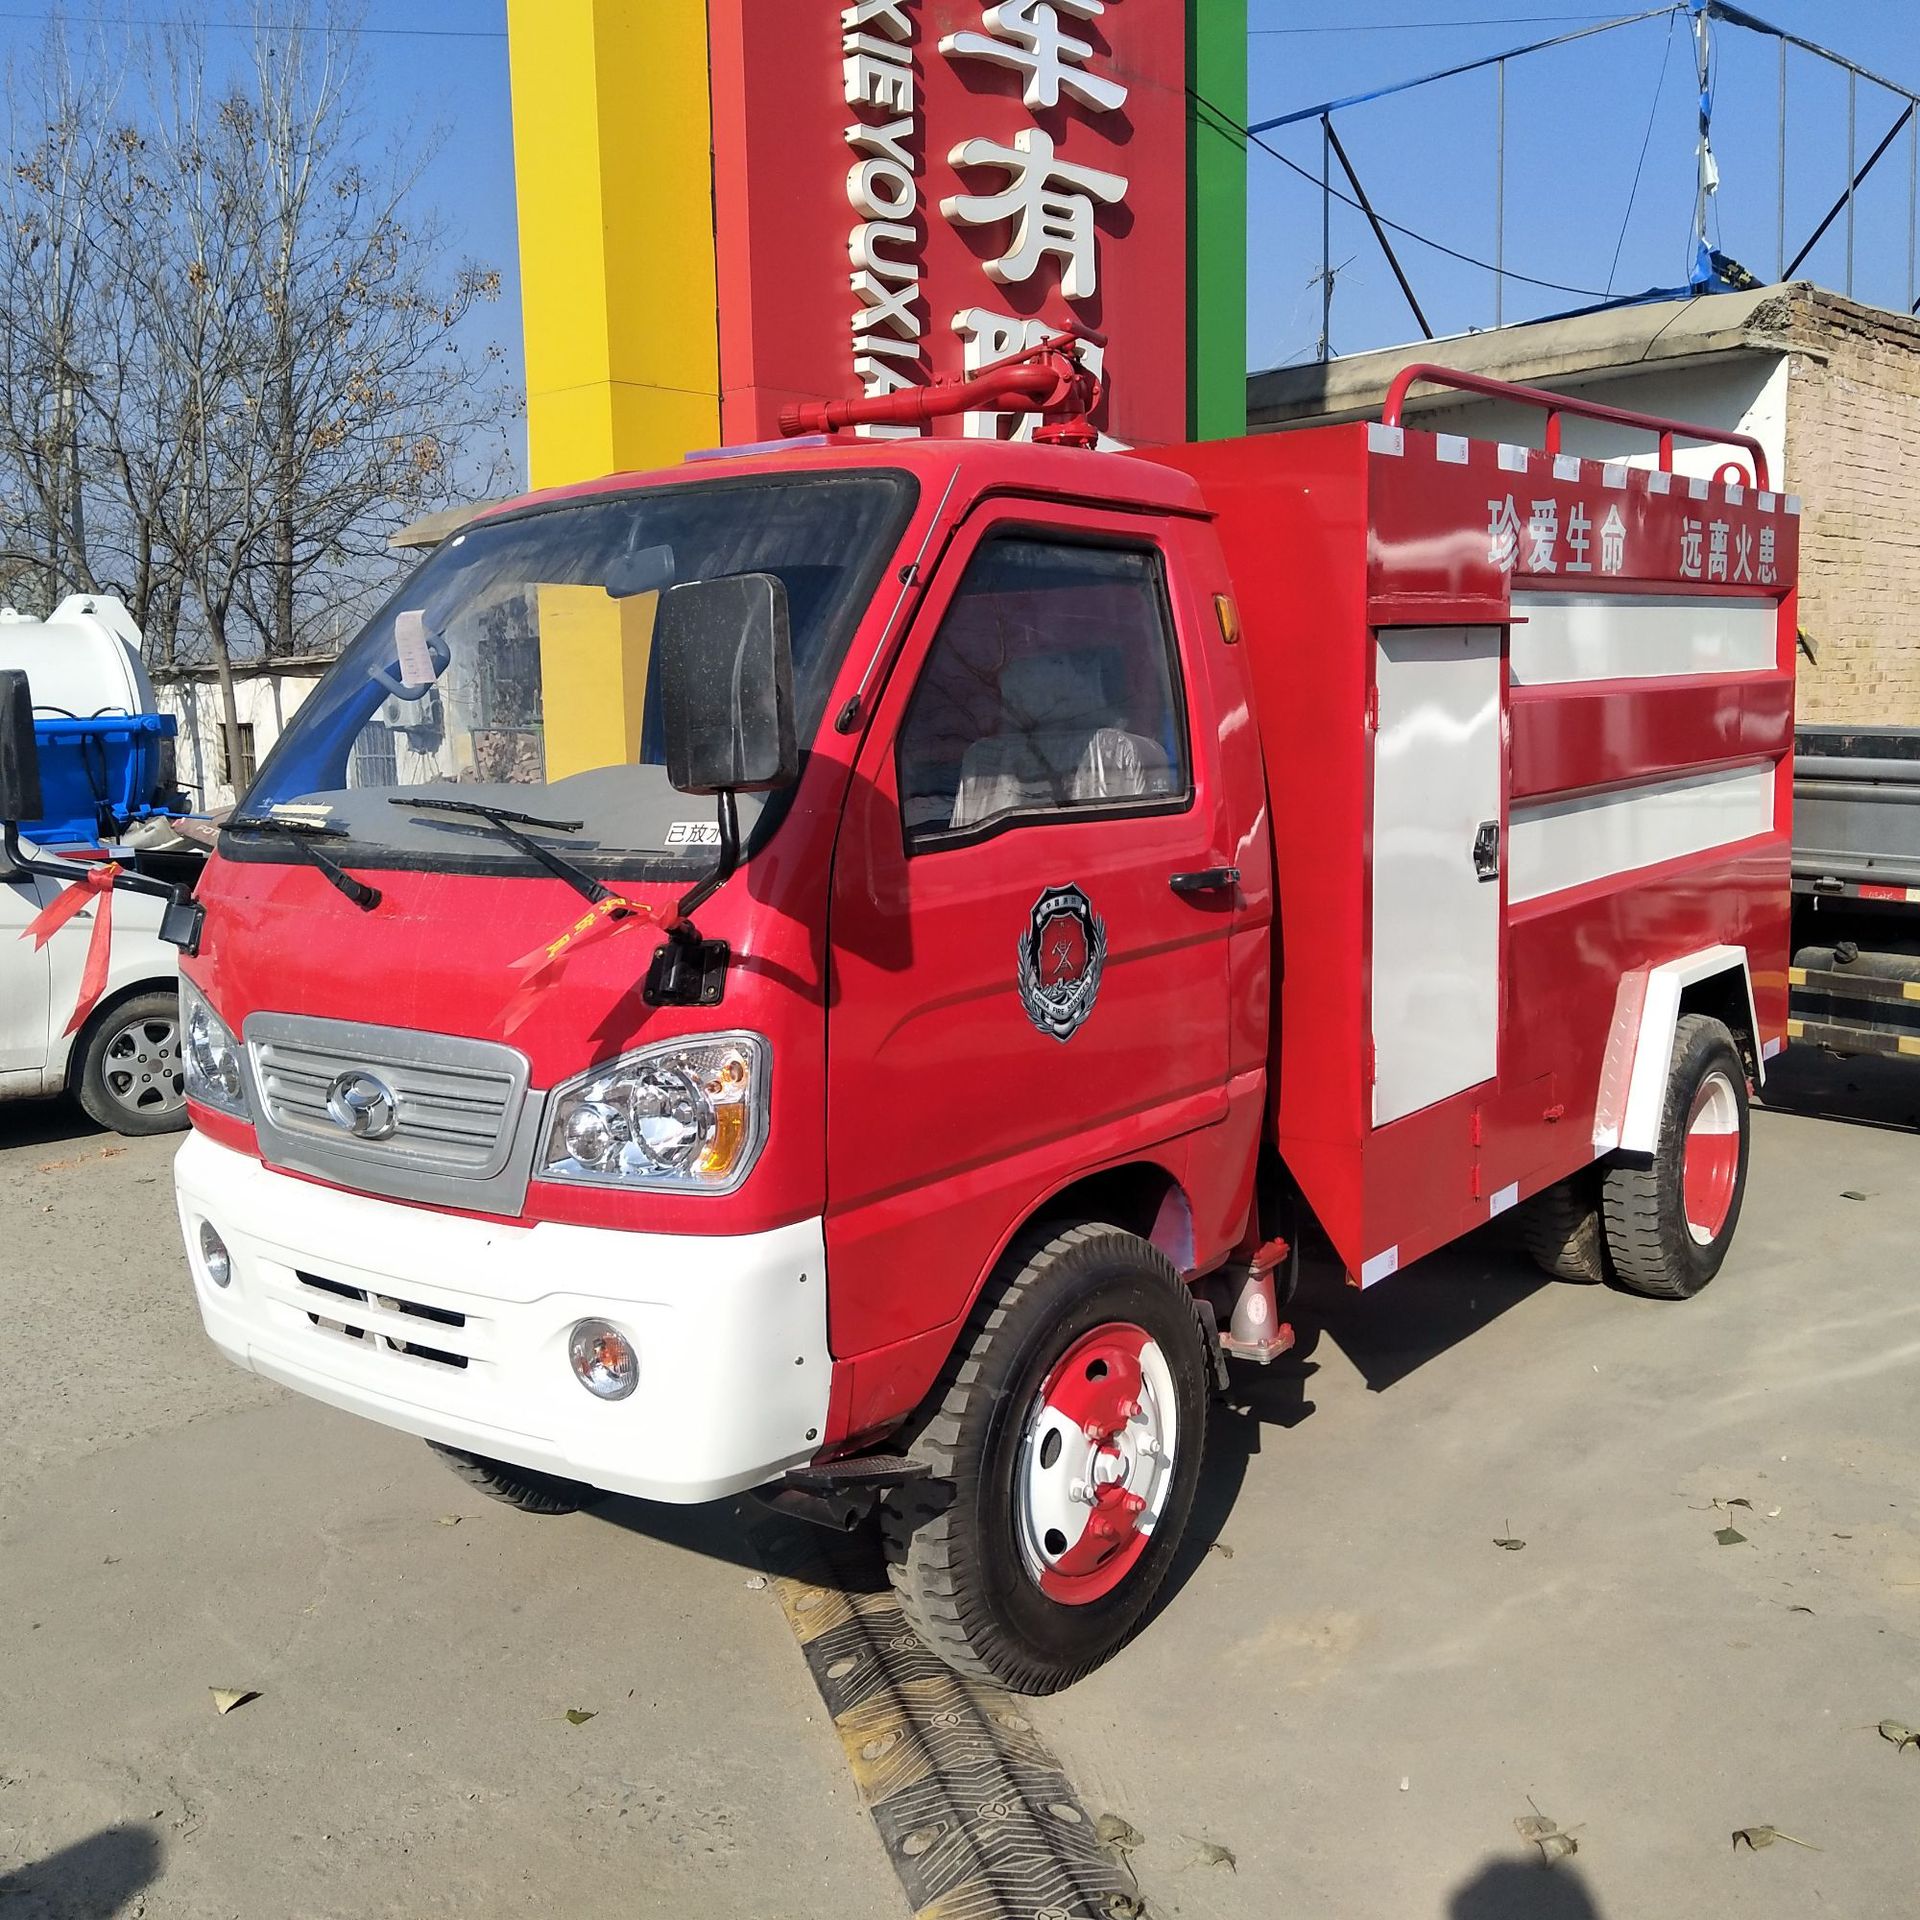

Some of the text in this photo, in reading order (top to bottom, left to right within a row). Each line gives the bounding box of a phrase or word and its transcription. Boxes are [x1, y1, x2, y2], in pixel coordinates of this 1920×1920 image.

[1487, 494, 1777, 584] 珍爱生命 远离火患
[1034, 992, 1050, 1010] CHINA
[1052, 1006, 1065, 1016] FIRE
